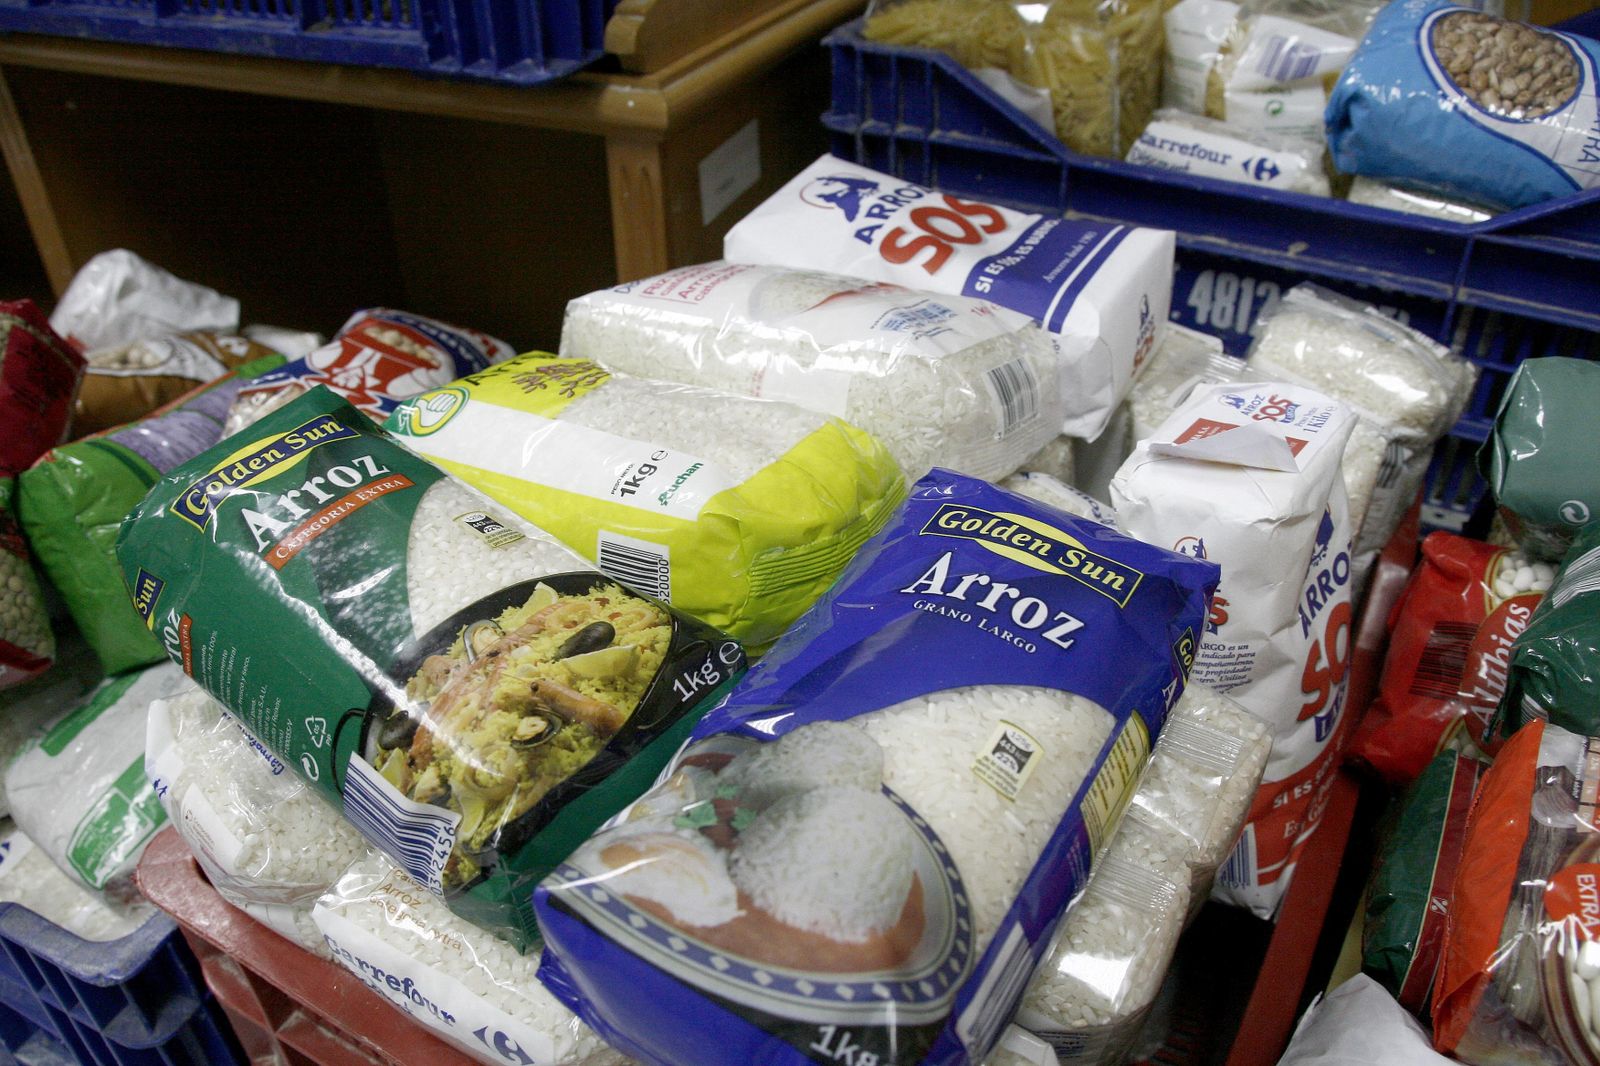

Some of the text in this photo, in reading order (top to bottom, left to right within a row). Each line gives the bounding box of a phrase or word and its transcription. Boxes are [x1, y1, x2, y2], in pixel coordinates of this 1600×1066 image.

[1139, 132, 1232, 165] Carrefour
[879, 194, 1008, 276] SOS
[975, 276, 994, 294] SI
[1240, 393, 1266, 417] ARROZ
[1252, 393, 1295, 422] SOS
[1307, 411, 1332, 428] Kilo
[185, 417, 346, 516] Golden Sun
[620, 463, 658, 498] 1kg
[241, 454, 392, 553] Arroz
[355, 480, 405, 502] EXTRA
[610, 478, 622, 495] PESO
[937, 509, 1126, 592] Golden Sun
[135, 579, 157, 615] Sun
[900, 551, 1086, 651] Arroz
[1298, 543, 1352, 640] ARRO
[209, 630, 218, 650] 100%
[912, 599, 1037, 655] GRANO LARGO
[1296, 602, 1351, 722] SO
[672, 658, 721, 703] 1kg
[996, 753, 1017, 770] 22%
[999, 739, 1017, 754] 443
[379, 882, 423, 910] Arroz
[1576, 873, 1600, 927] EXTRA
[323, 934, 456, 1027] Carrefour
